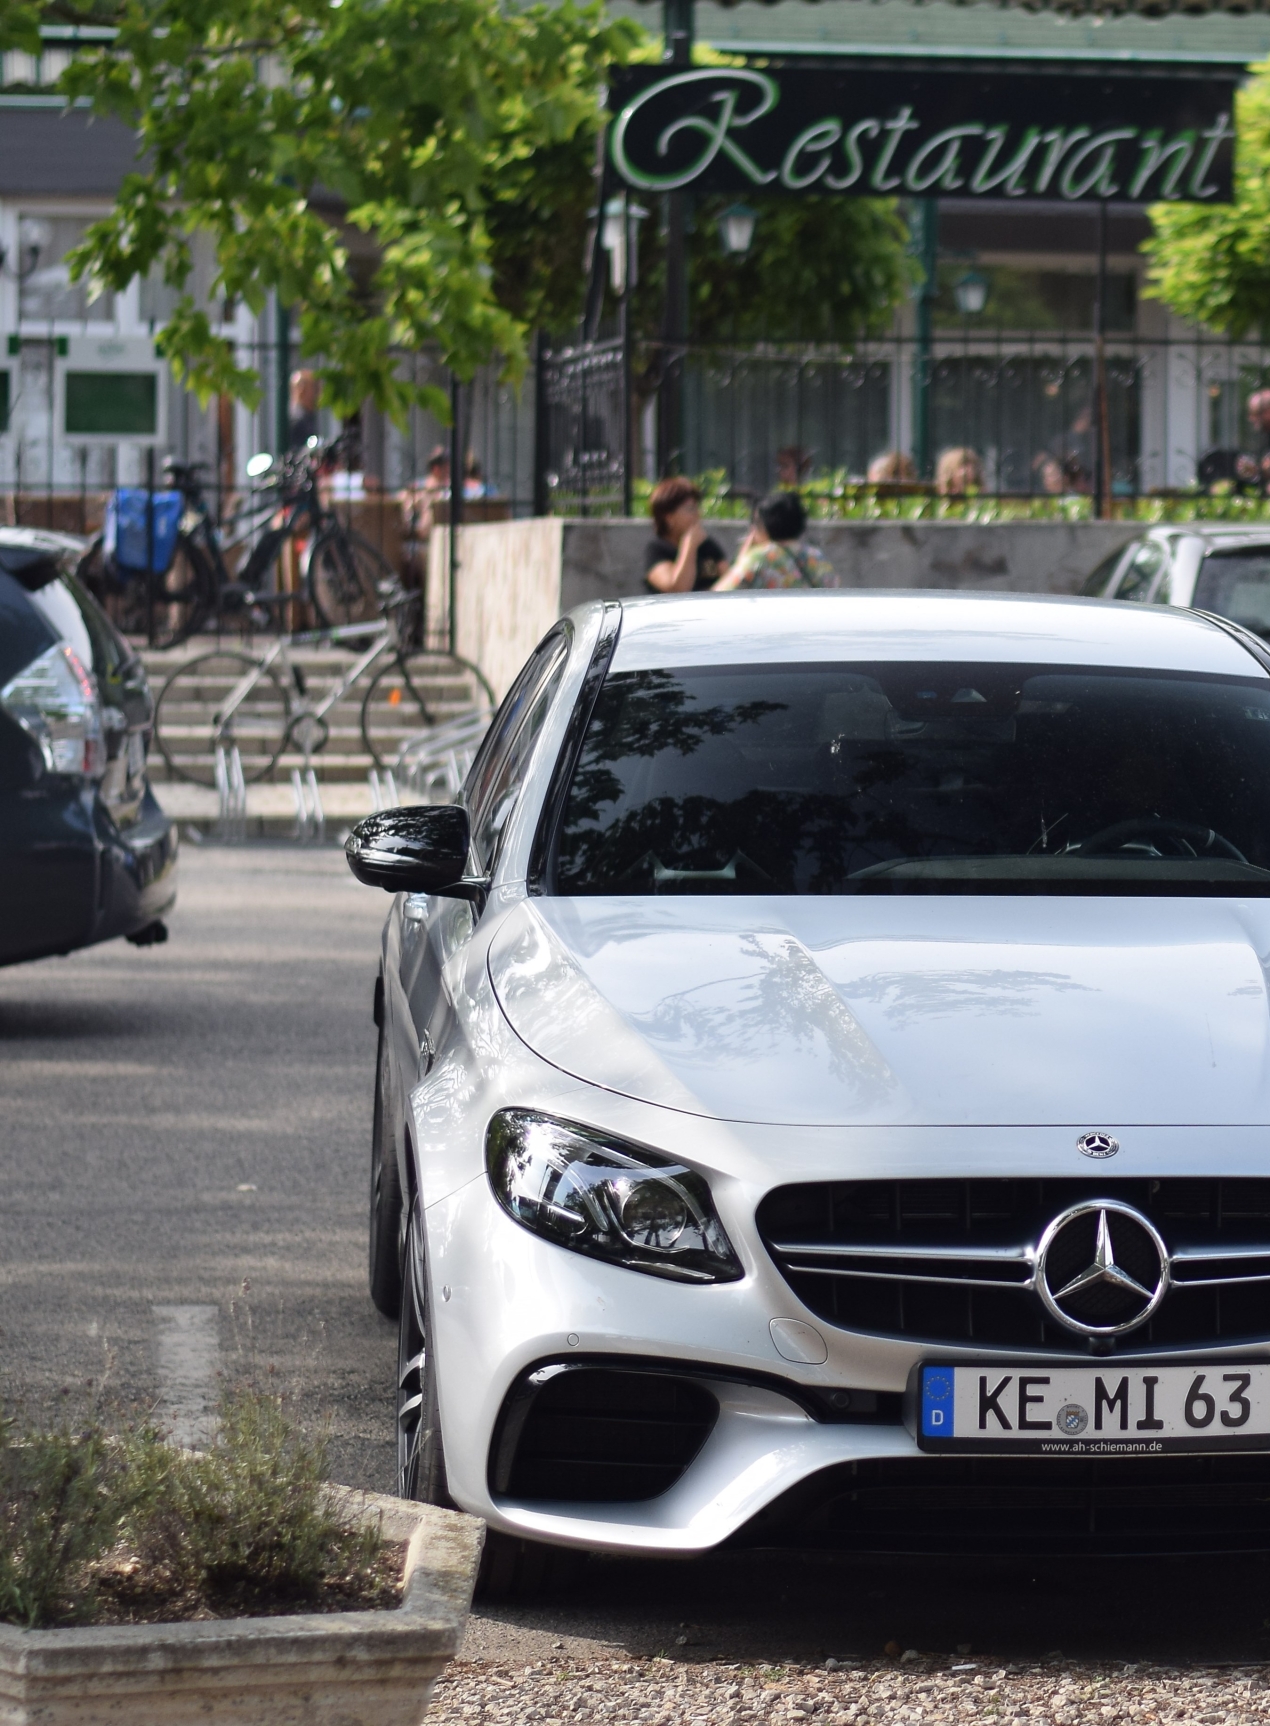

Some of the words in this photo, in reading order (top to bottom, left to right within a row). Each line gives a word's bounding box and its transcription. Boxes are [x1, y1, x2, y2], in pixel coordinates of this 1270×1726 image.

[610, 68, 1236, 199] Restaurant
[931, 1409, 944, 1425] D
[979, 1375, 1053, 1431] KE
[1094, 1375, 1165, 1430] MI
[1184, 1372, 1252, 1429] 63
[1041, 1440, 1163, 1452] www.ah-schiemann.de
